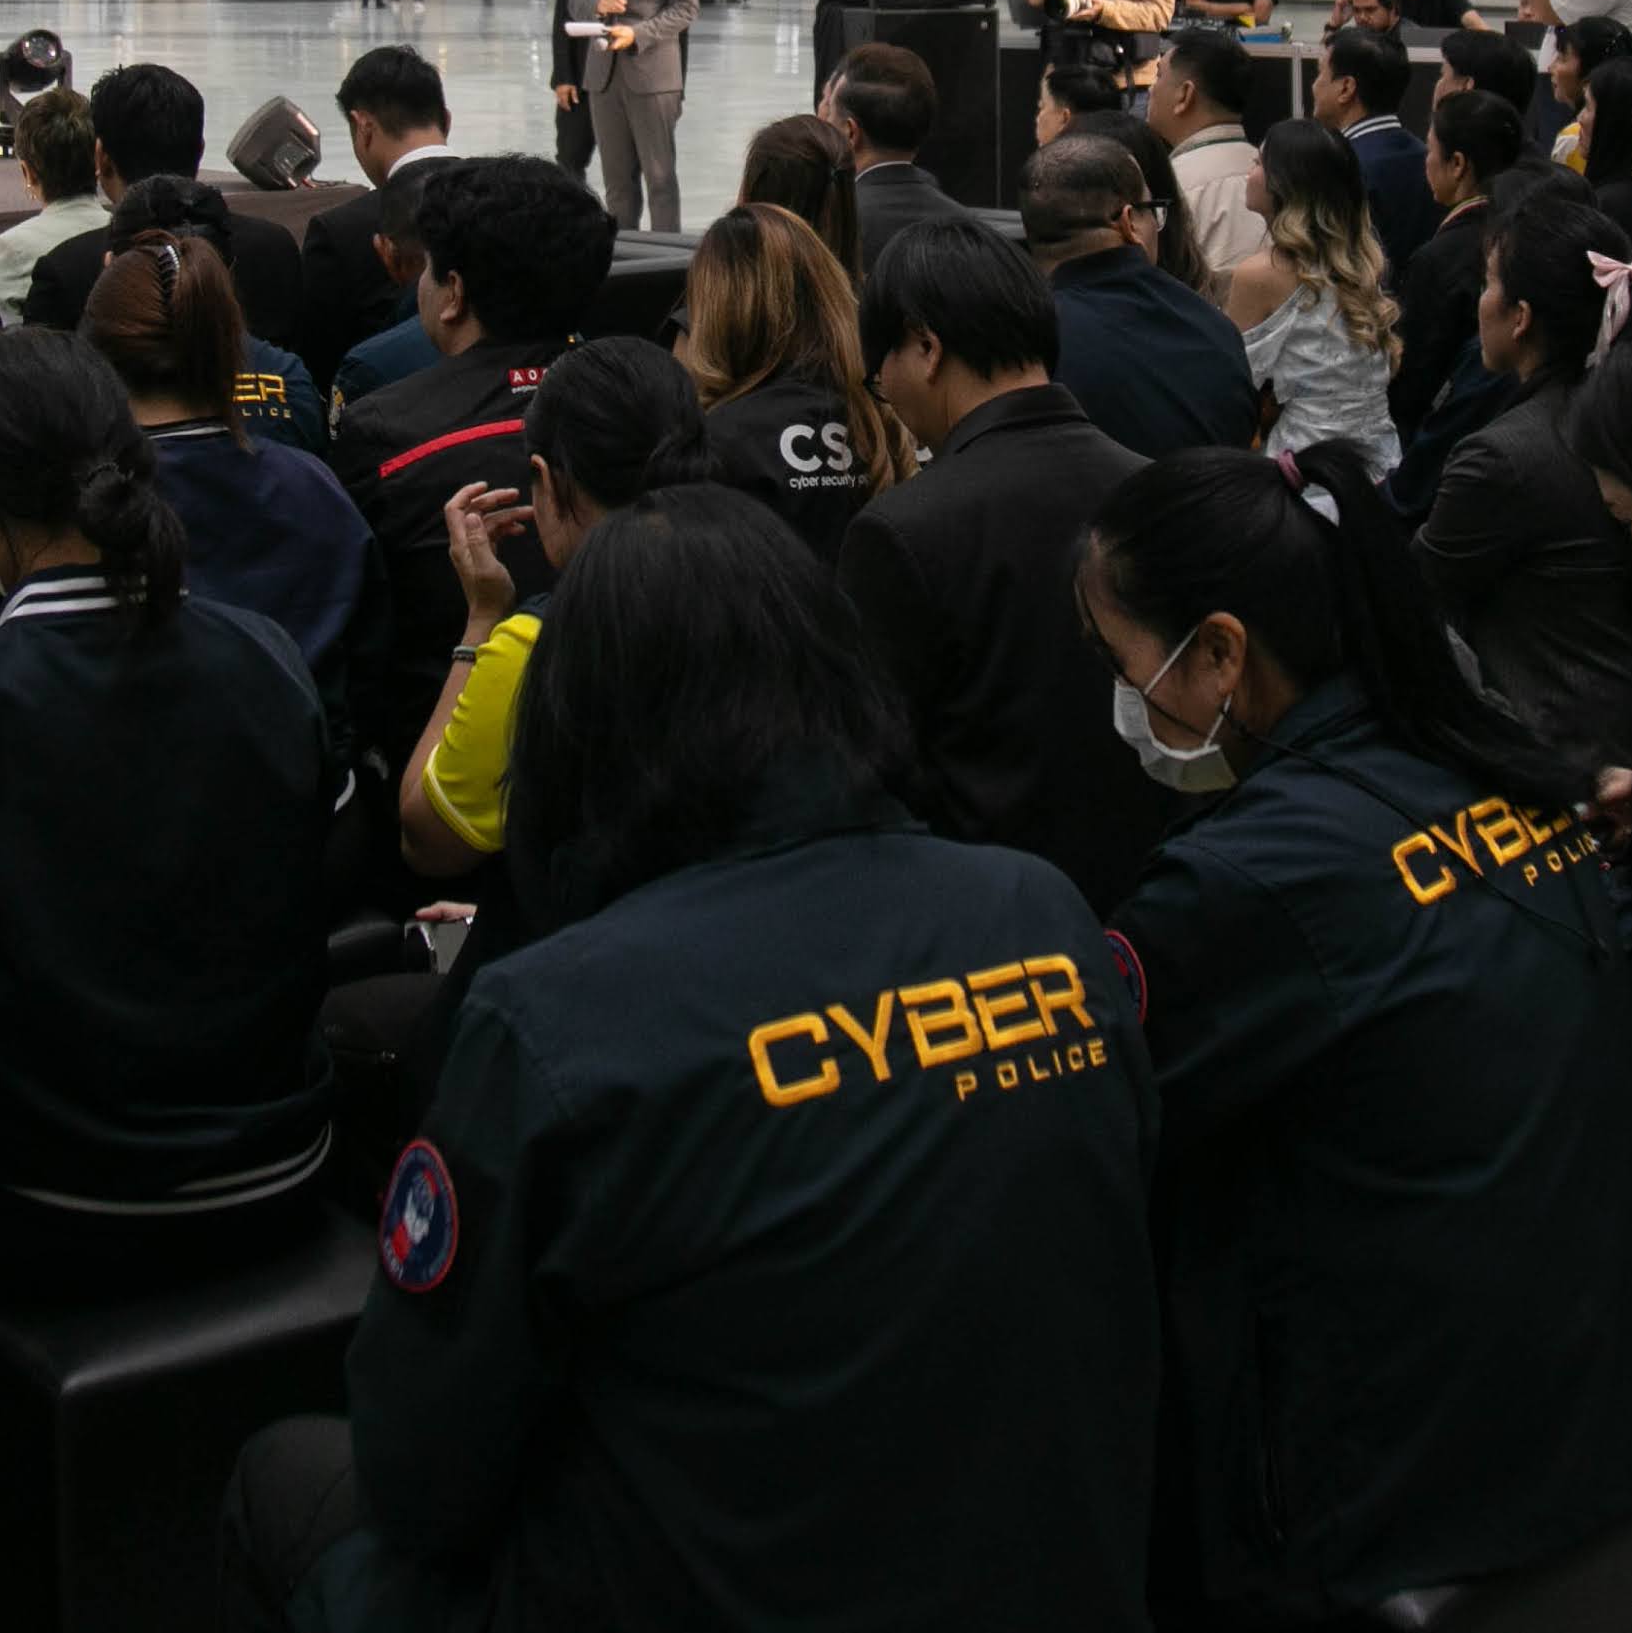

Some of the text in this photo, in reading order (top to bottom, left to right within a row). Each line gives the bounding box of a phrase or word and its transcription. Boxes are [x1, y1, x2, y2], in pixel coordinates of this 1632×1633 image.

[789, 474, 820, 490] cyber
[1390, 794, 1574, 907] CYBE
[748, 953, 1095, 1108] CYBER
[955, 1037, 1108, 1102] POLICE
